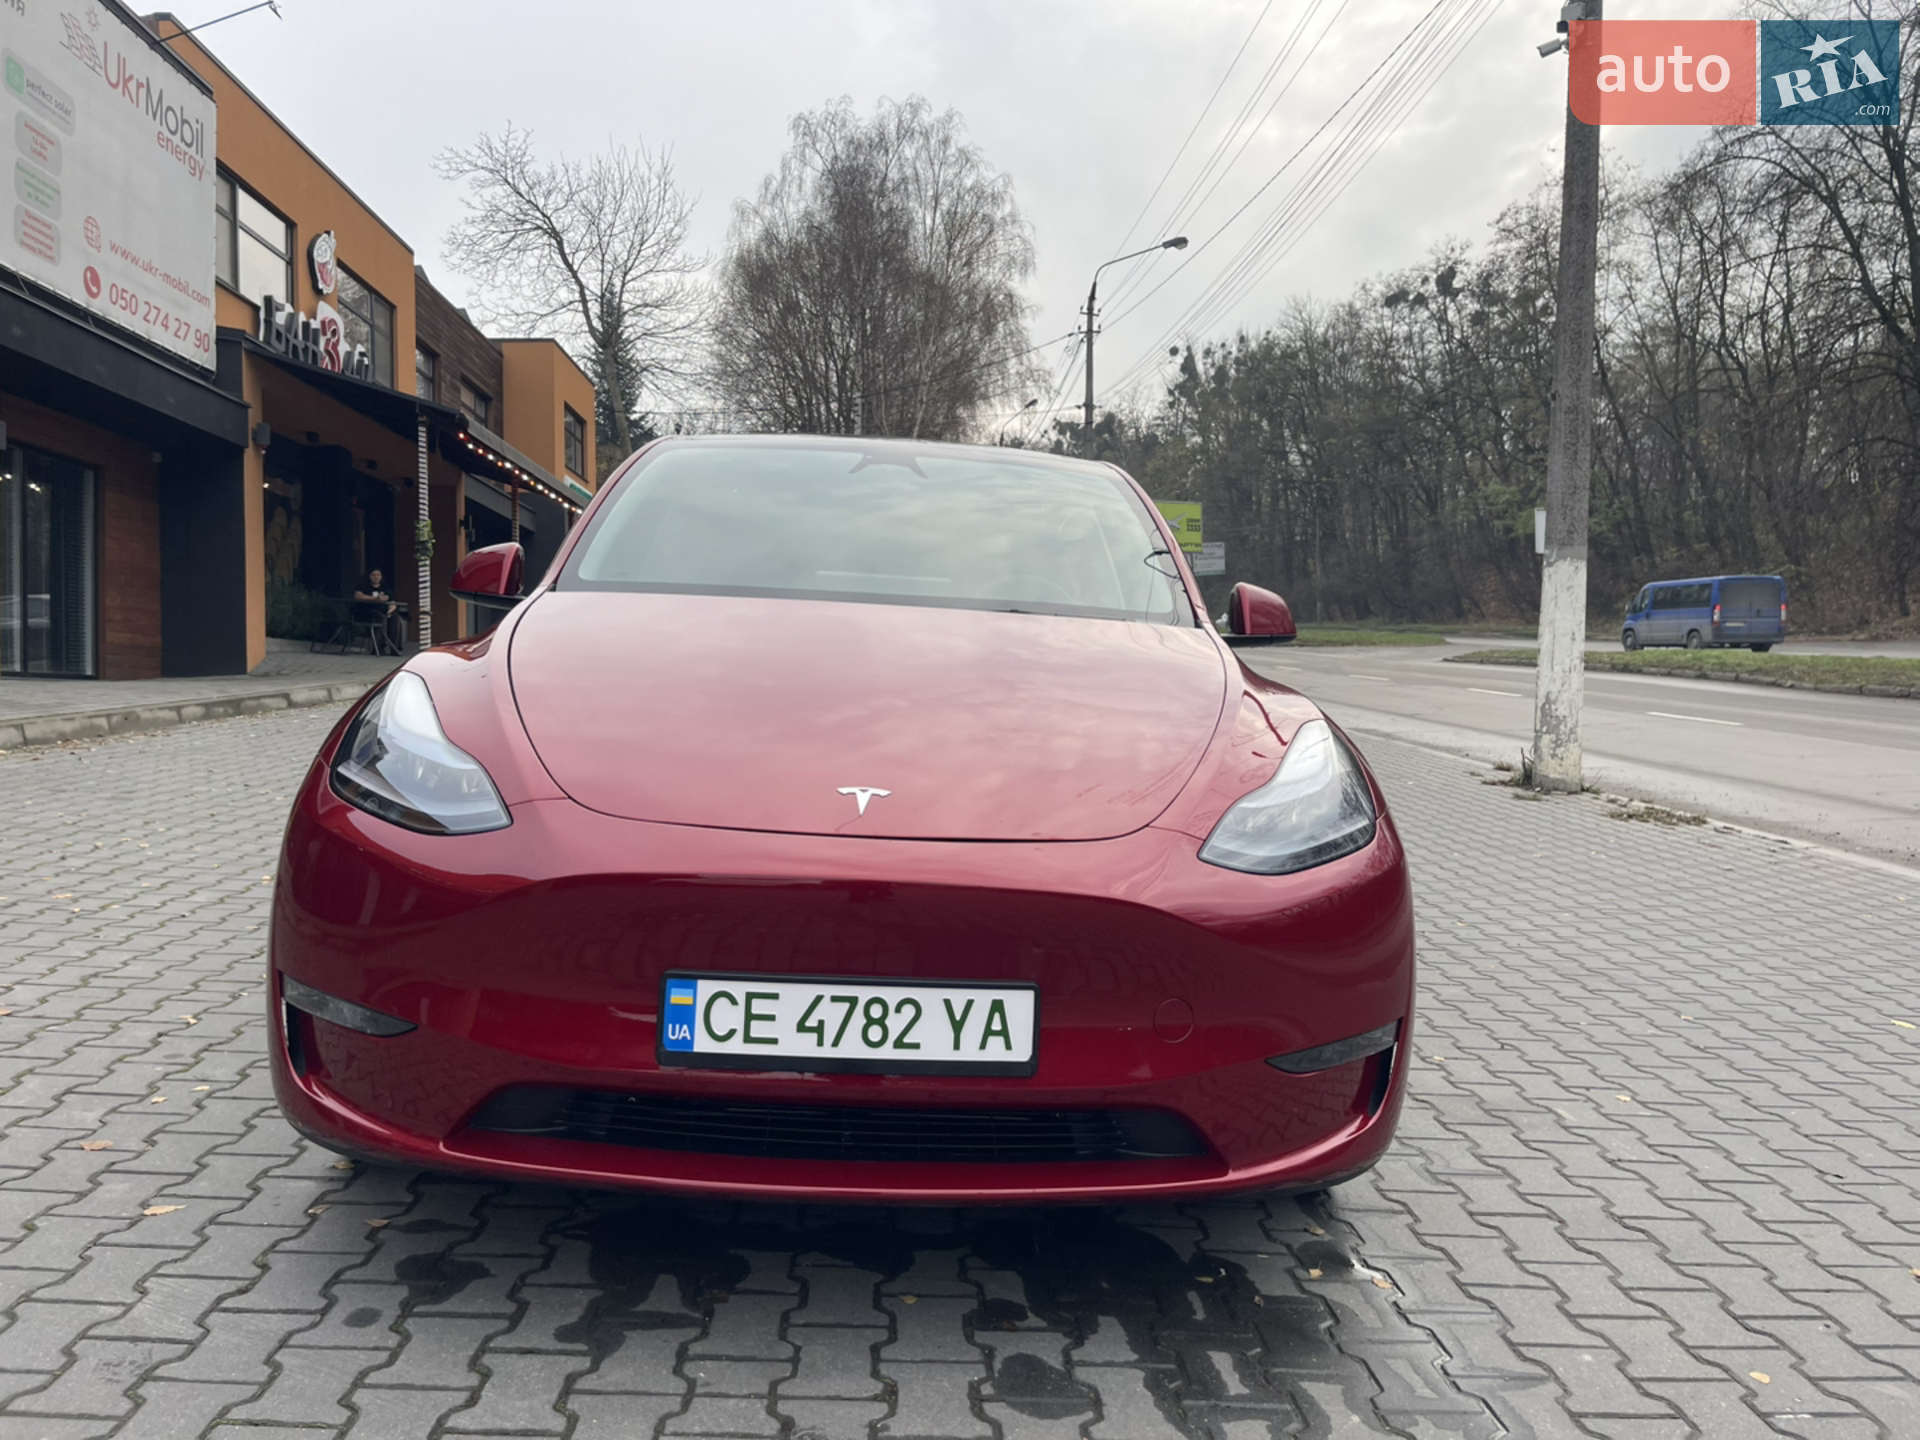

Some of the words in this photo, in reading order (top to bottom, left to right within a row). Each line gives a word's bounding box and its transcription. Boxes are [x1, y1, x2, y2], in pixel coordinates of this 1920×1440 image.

[103, 41, 204, 158] UkrMobil
[157, 131, 205, 181] energy
[109, 240, 211, 308] www.ukr-mobil.com
[109, 283, 139, 316] 050
[143, 301, 170, 332] 274
[173, 318, 191, 342] 27
[194, 329, 210, 353] 90
[668, 1024, 691, 1041] UA
[703, 990, 780, 1045] CE
[796, 994, 922, 1050] 4782
[942, 998, 1013, 1051] YA
